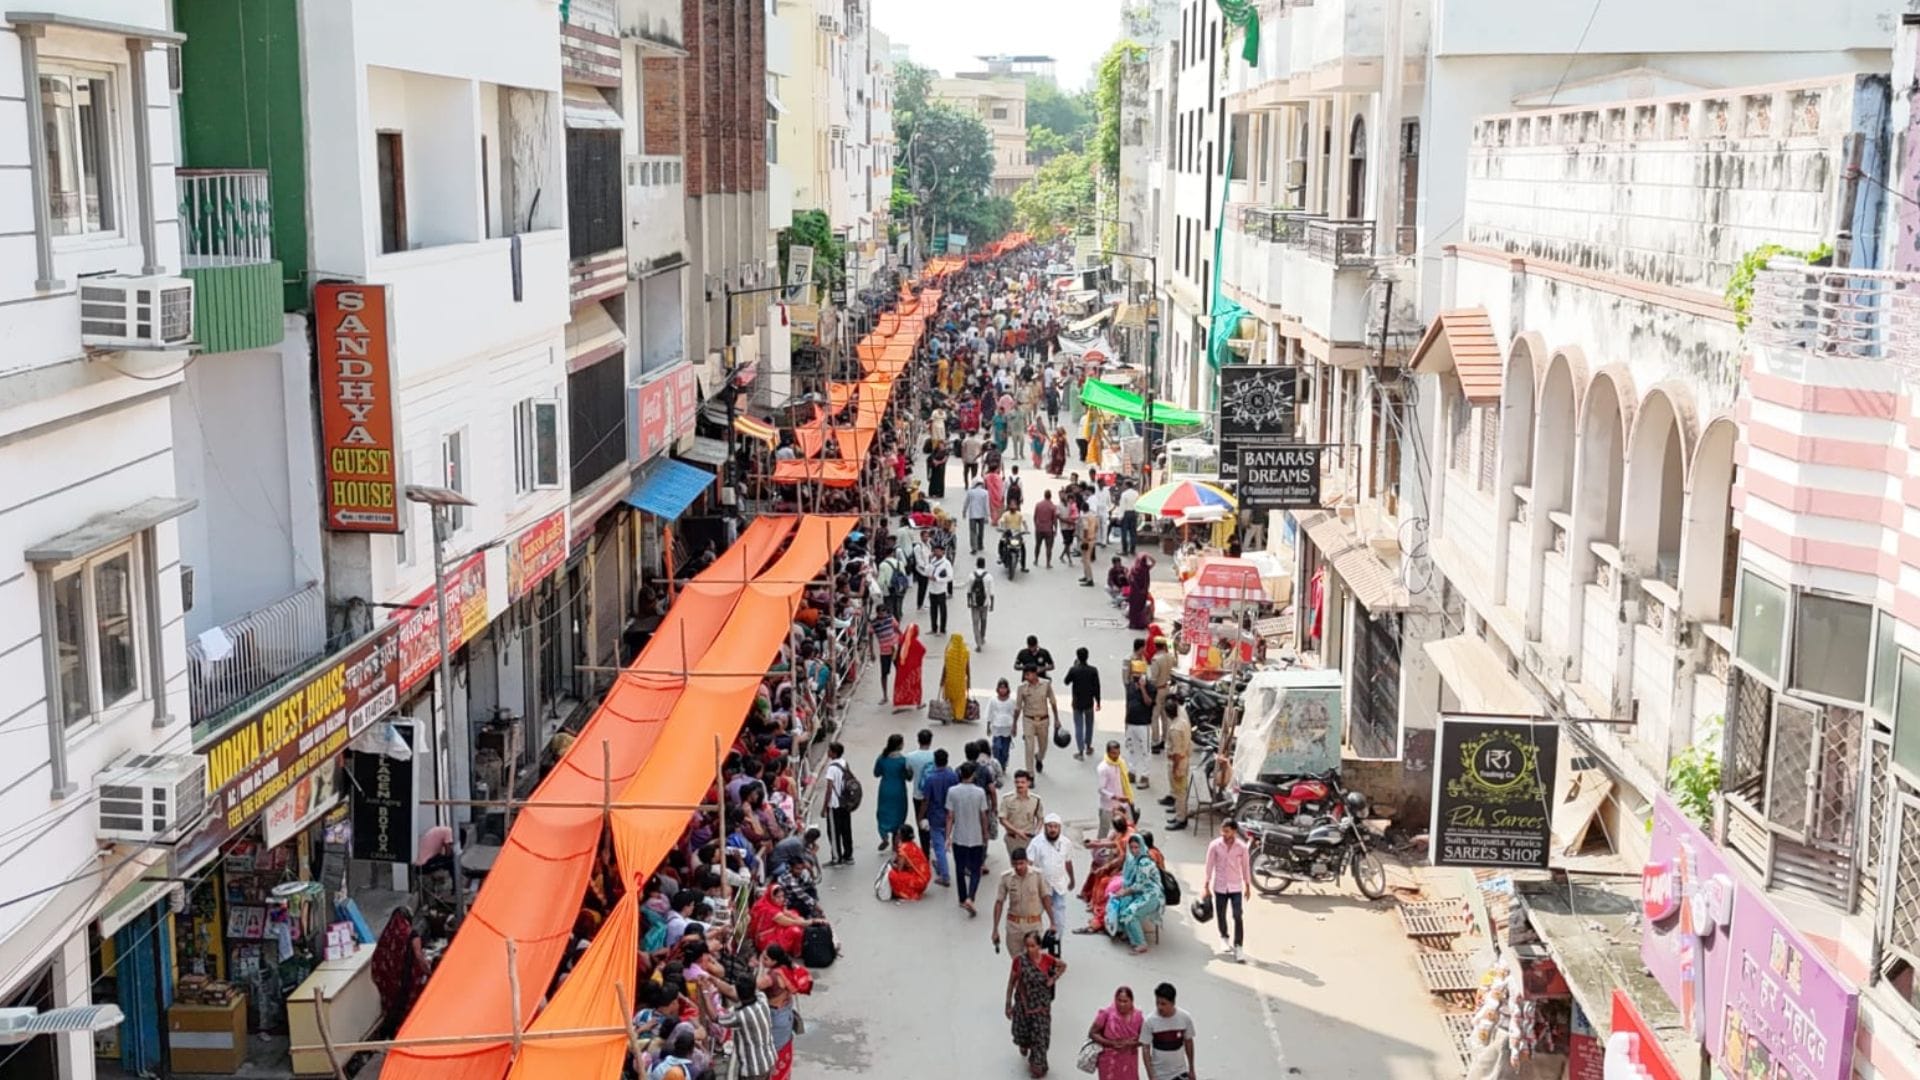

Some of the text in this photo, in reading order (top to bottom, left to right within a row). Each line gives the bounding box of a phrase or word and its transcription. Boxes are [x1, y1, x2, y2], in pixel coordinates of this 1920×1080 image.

[336, 291, 377, 444] SANDHYA
[332, 448, 391, 475] GUEST
[1244, 452, 1315, 466] BANARAS
[1249, 469, 1311, 483] DREAMS
[333, 481, 393, 508] HOUSE
[207, 722, 260, 796] NDHYA
[262, 691, 304, 759] GUEST
[306, 662, 346, 729] HOUSE
[376, 753, 391, 799] LAGEN
[378, 806, 389, 852] BOTOX
[1490, 809, 1545, 829] Sarees
[1444, 846, 1541, 862] SAREES SHOP
[1510, 839, 1542, 848] Fabrics
[1760, 970, 1780, 1013] हर
[1782, 991, 1828, 1070] महादेव
